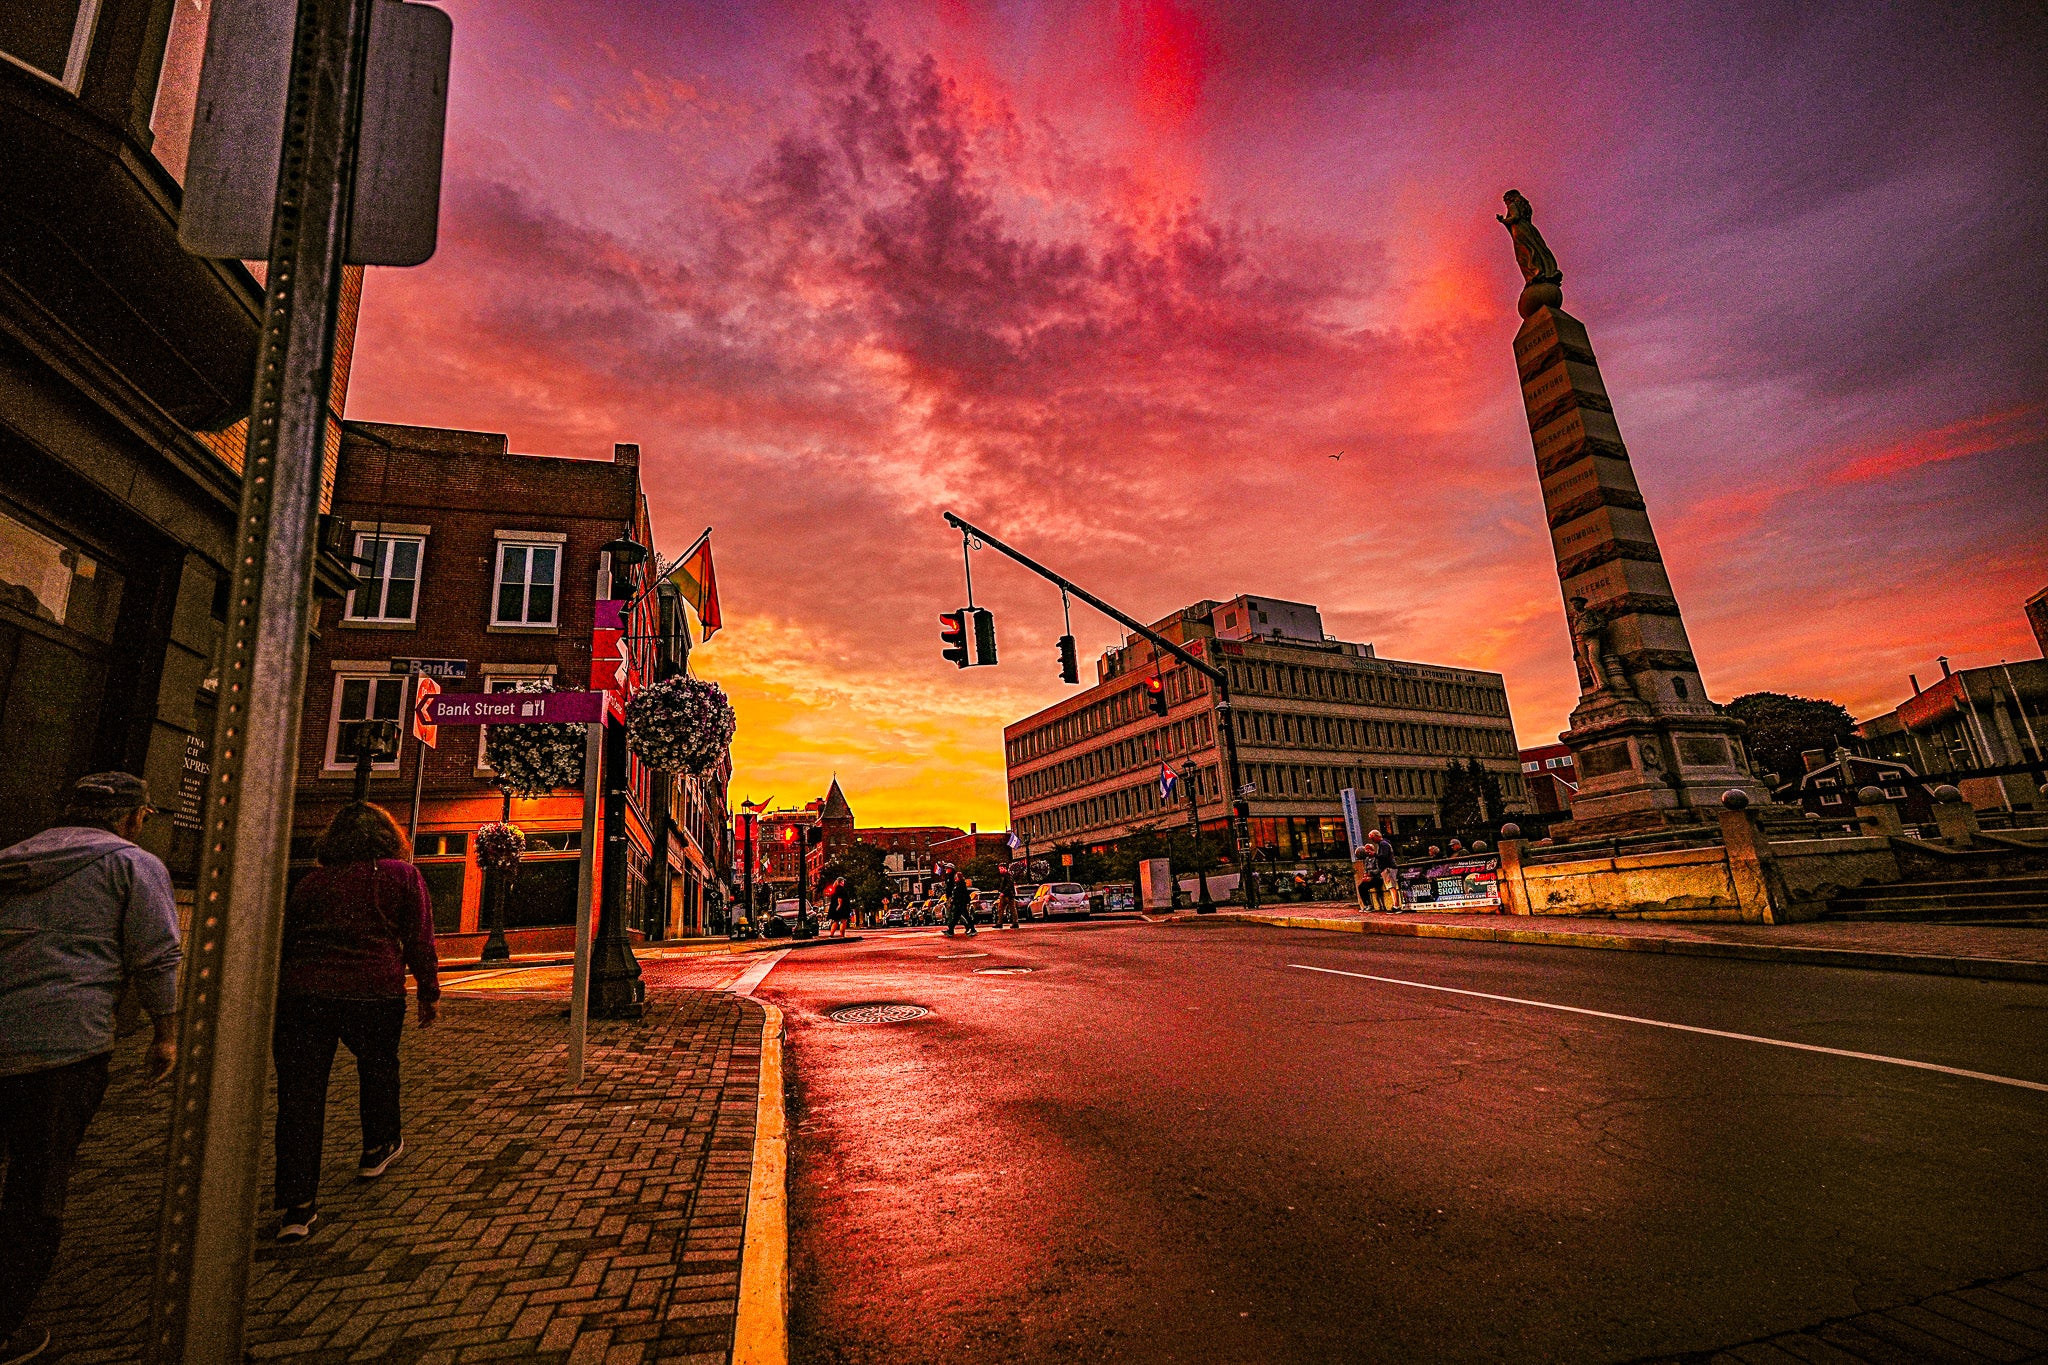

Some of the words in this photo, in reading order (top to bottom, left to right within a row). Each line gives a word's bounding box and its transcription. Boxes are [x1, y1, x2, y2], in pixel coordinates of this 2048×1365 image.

[409, 660, 453, 676] Bank
[437, 702, 471, 716] Bank
[474, 702, 515, 716] Street
[1438, 880, 1463, 888] DRONE
[1438, 887, 1464, 895] SHOW!
